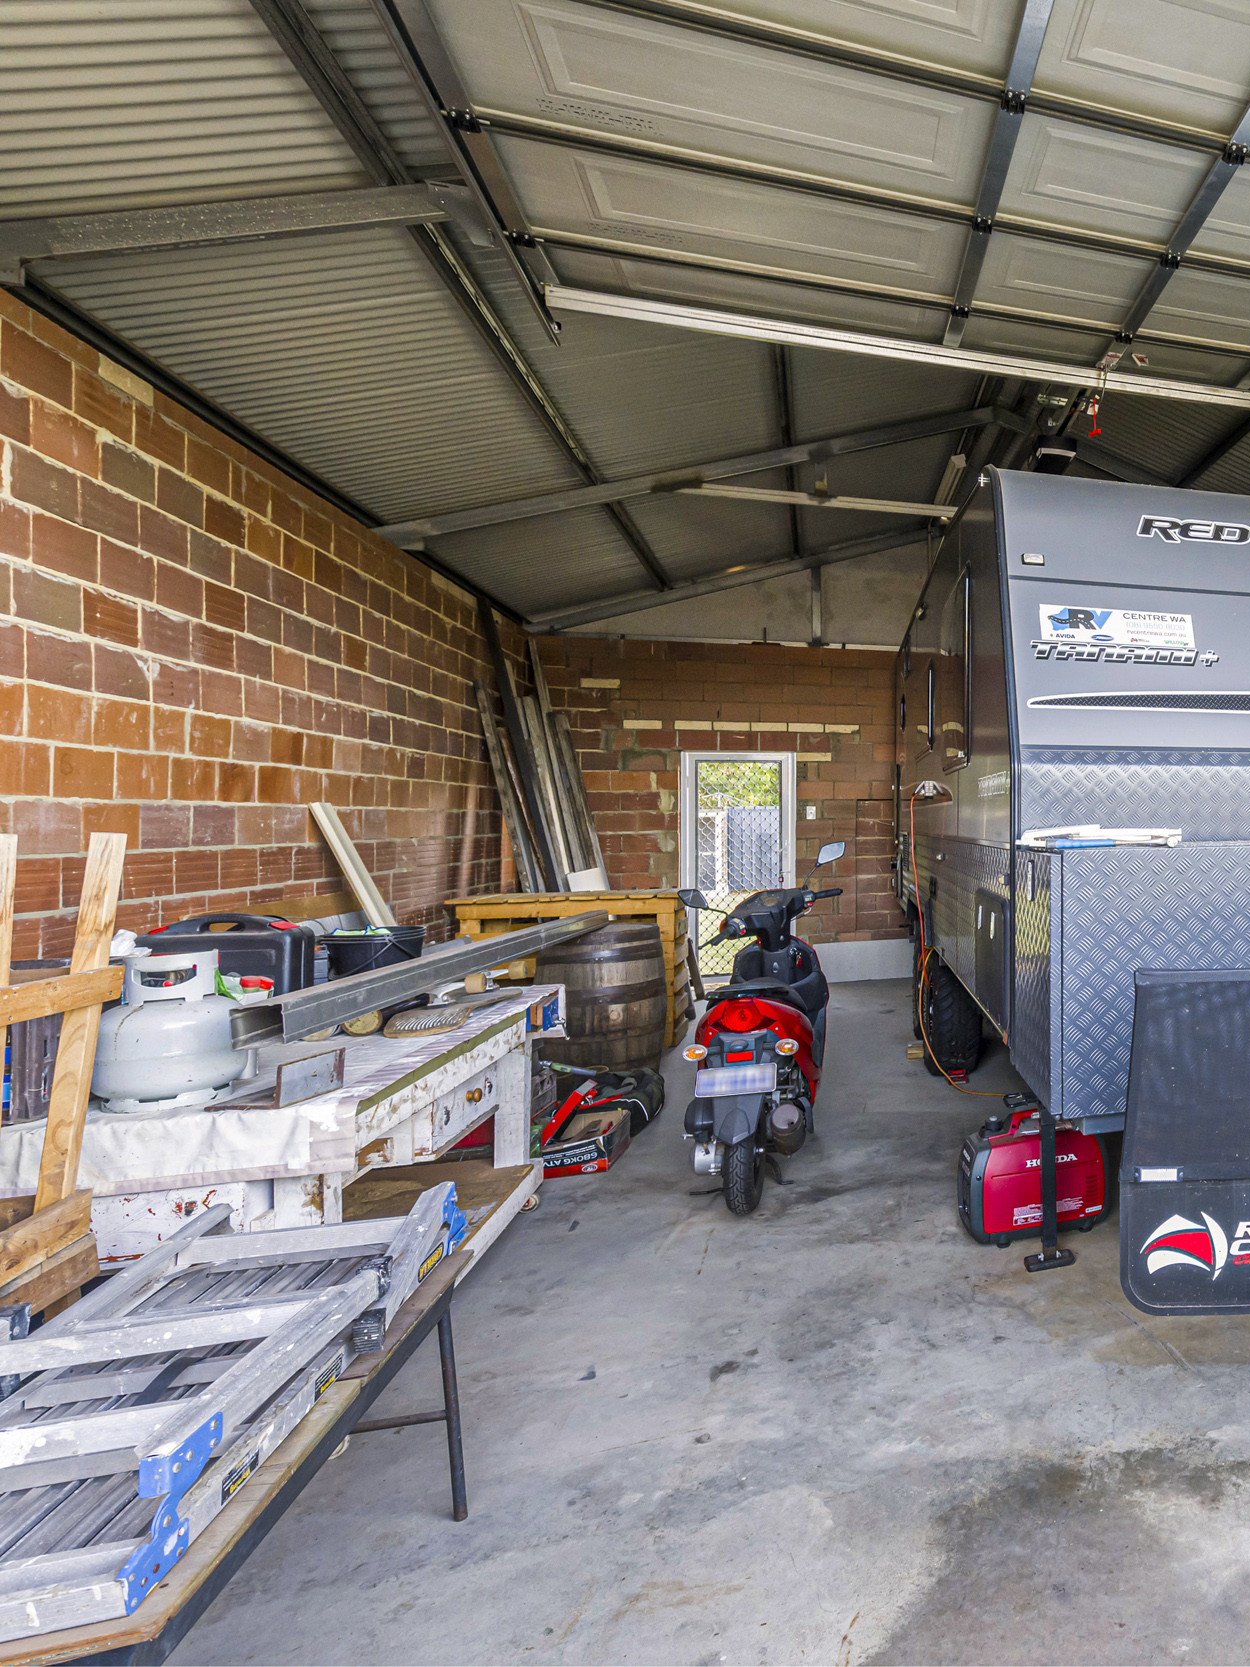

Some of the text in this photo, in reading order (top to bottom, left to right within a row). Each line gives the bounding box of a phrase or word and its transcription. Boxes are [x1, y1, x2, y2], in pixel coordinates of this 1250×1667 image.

[1068, 609, 1187, 630] RV CENTRE WA
[563, 1151, 598, 1165] 680KG
[1025, 1153, 1078, 1168] HDA
